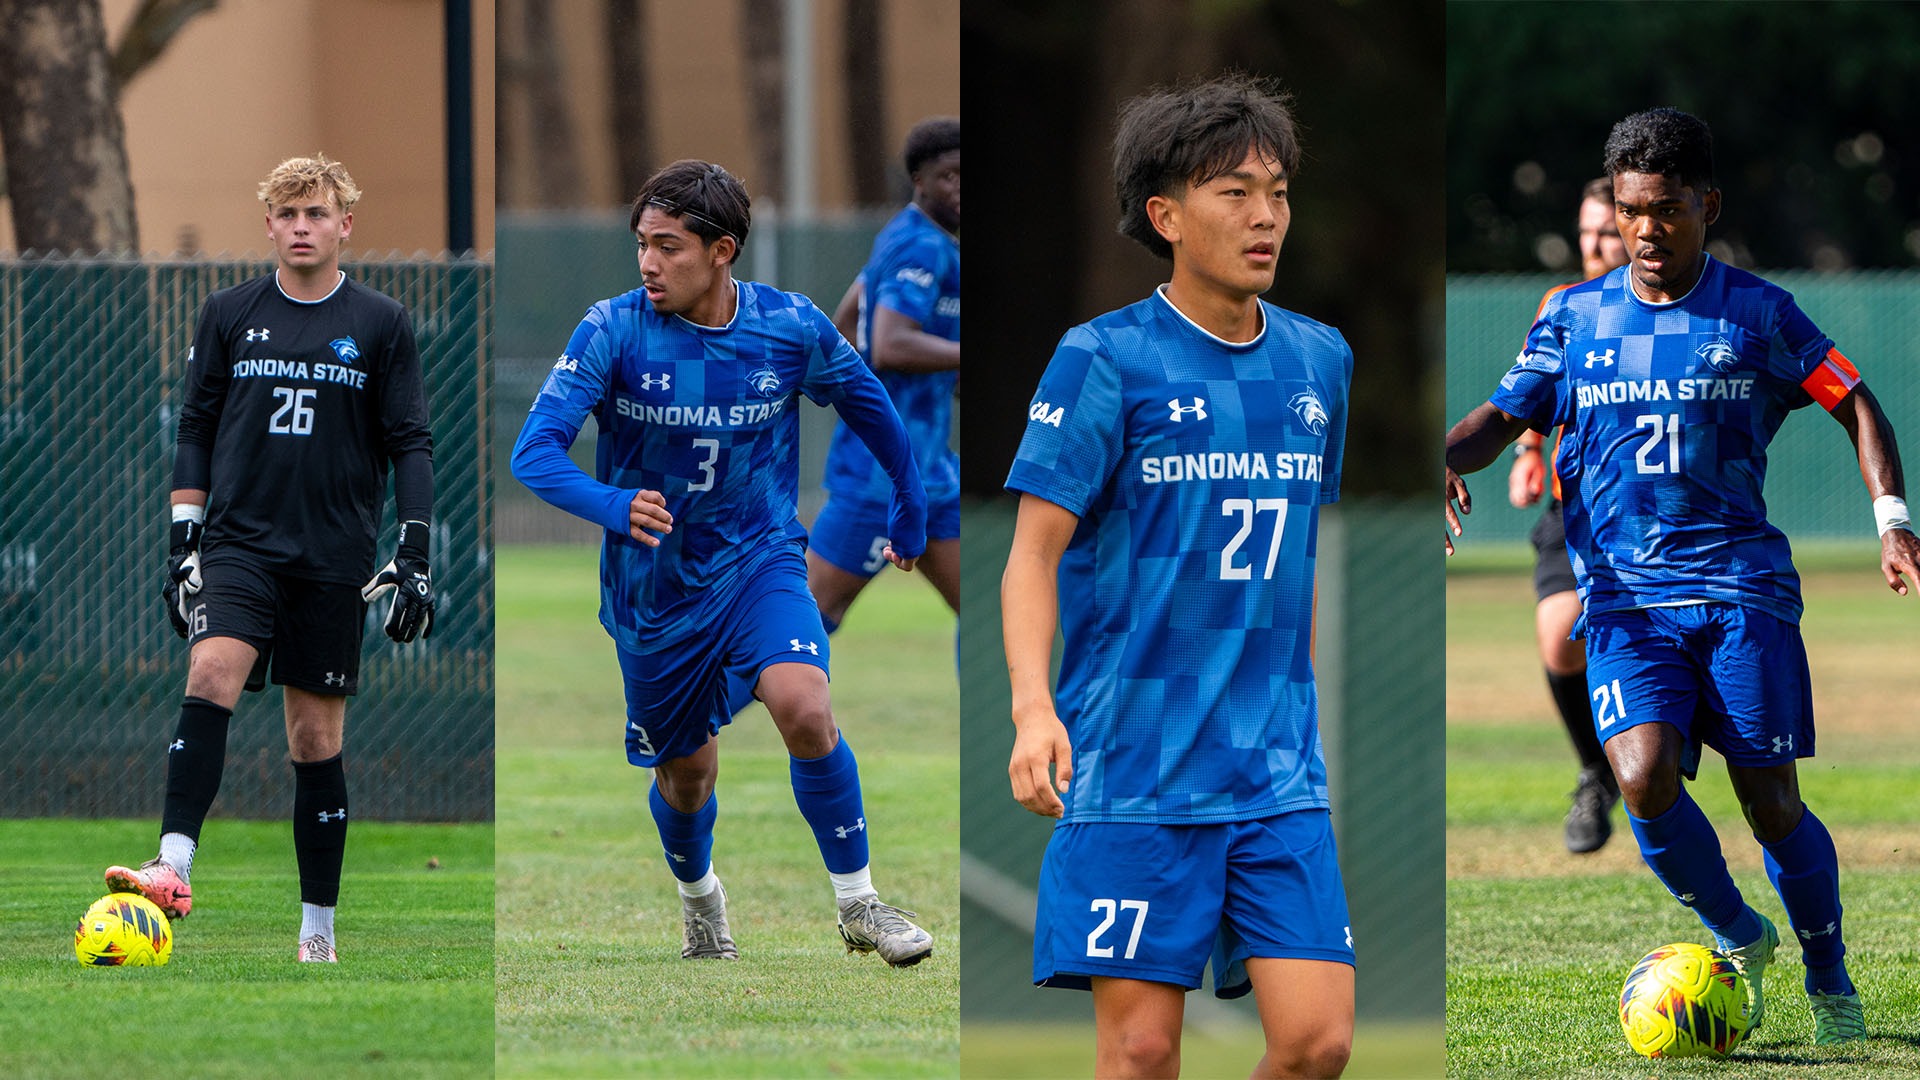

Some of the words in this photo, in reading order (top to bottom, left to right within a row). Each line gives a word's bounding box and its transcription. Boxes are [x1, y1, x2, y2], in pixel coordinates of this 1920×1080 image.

[313, 363, 367, 390] STATE
[1576, 379, 1672, 408] SONOMA
[1678, 378, 1754, 400] STATE
[268, 386, 317, 435] 26
[616, 397, 722, 427] SONOMA
[687, 438, 719, 492] 3
[1142, 452, 1270, 484] SONOMA
[1635, 413, 1680, 474] 21
[1219, 498, 1288, 580] 27
[1592, 678, 1627, 731] 21
[630, 722, 656, 756] 3
[1086, 898, 1149, 960] 27
